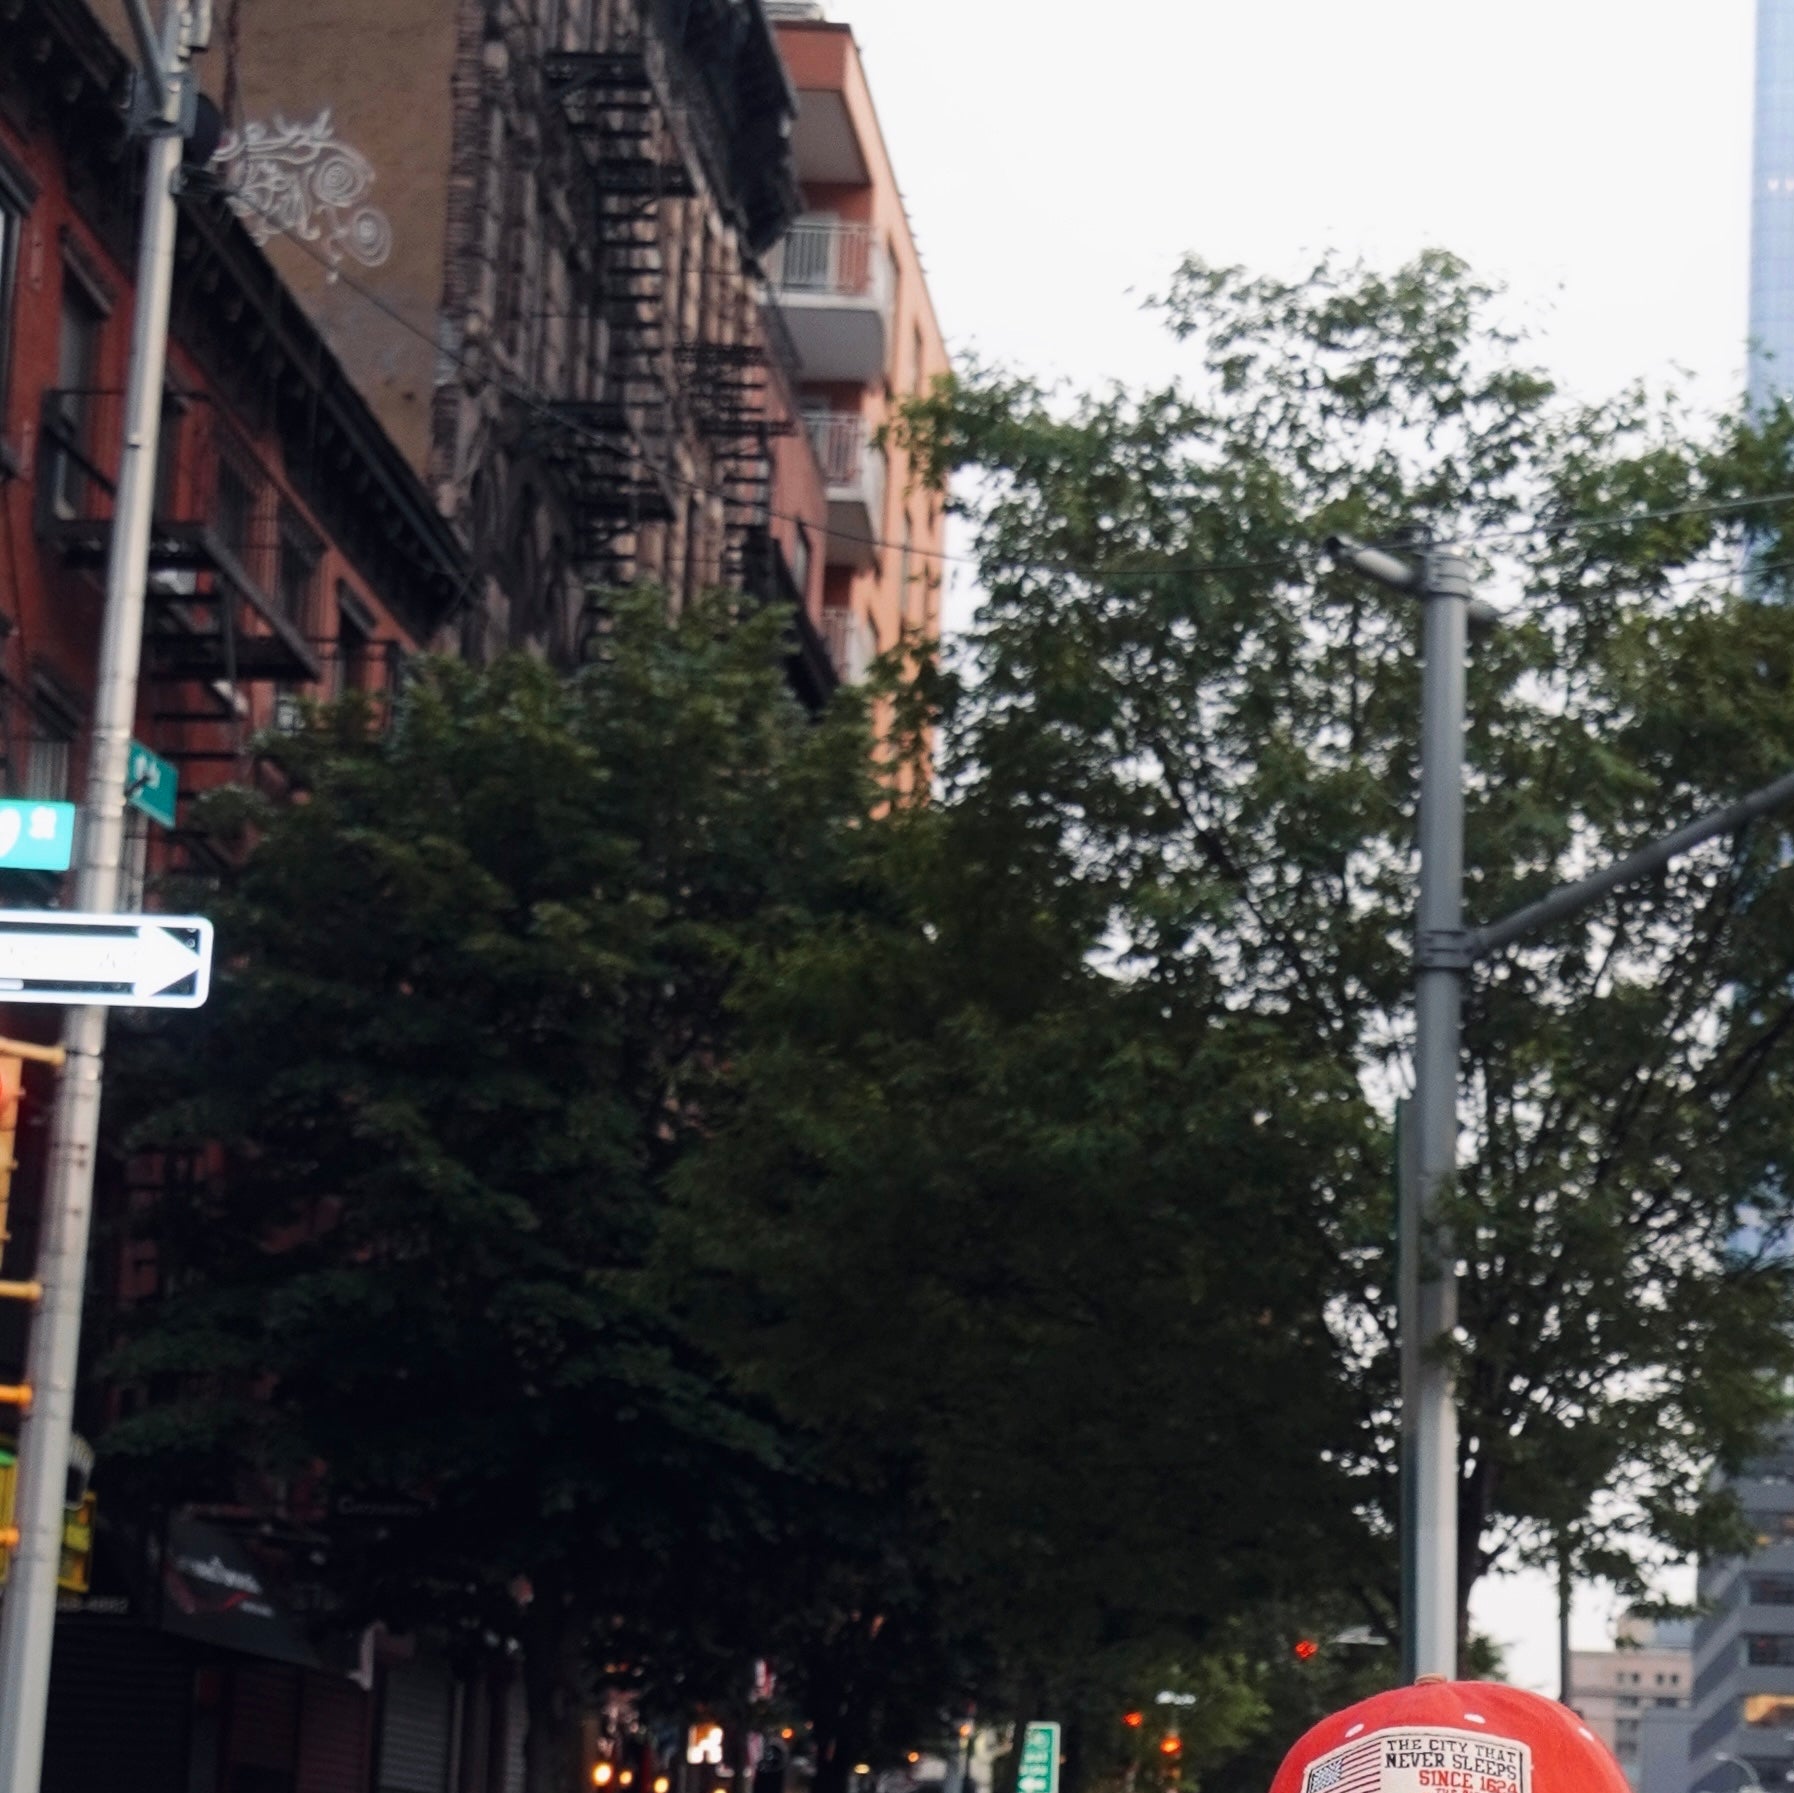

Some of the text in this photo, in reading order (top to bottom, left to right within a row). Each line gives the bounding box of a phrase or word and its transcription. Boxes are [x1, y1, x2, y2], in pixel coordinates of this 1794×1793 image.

[1387, 1739, 1516, 1763] THE CITY THAT
[1385, 1751, 1517, 1781] NEVER SLEEPS
[1419, 1770, 1473, 1790] SINCE
